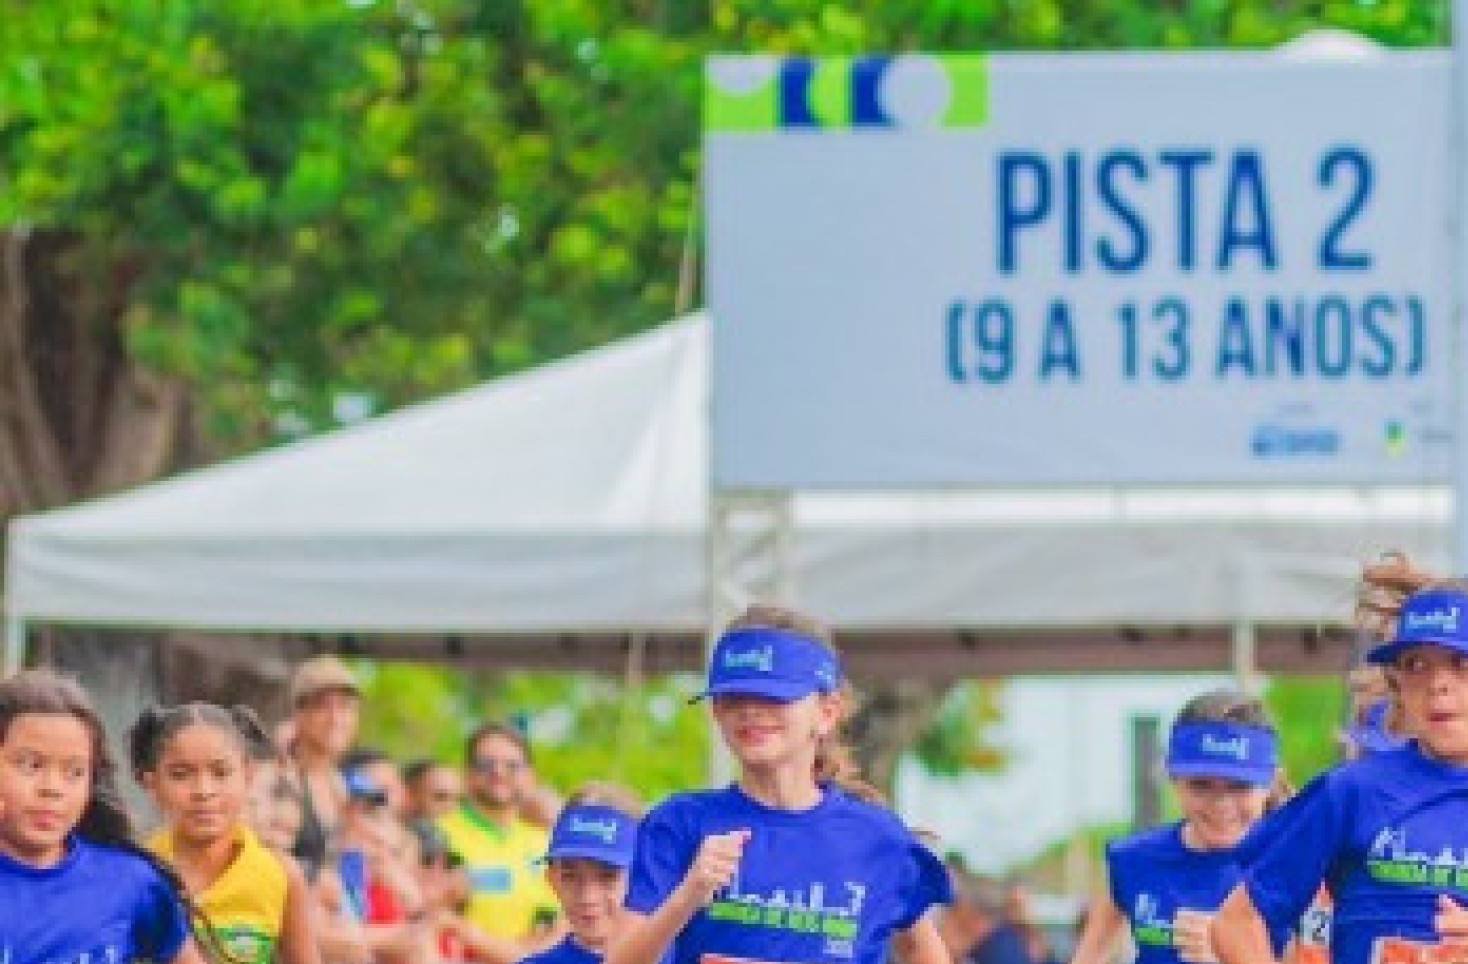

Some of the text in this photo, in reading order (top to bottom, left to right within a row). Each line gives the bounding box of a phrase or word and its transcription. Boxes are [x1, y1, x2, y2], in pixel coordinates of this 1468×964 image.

[996, 148, 1375, 275] PISTA 2
[944, 298, 1428, 384] (9 A 13 ANOS)
